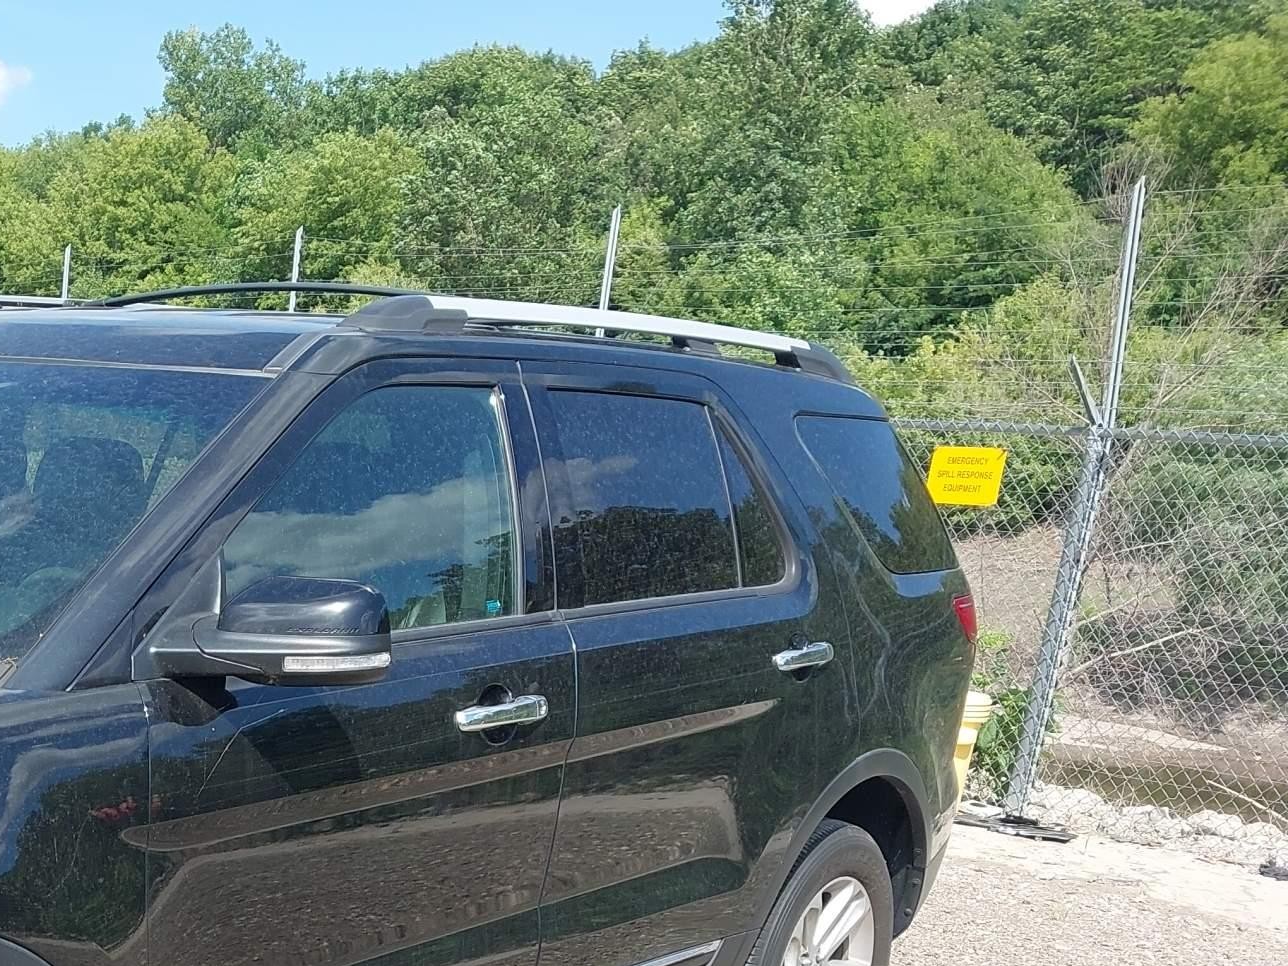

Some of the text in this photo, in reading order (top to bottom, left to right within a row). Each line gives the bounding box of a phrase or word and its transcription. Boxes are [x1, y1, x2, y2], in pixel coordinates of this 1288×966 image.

[947, 456, 990, 465] EMERGENCY
[937, 470, 994, 480] SPILL RESPONSE
[943, 483, 982, 493] EQUIPMENT
